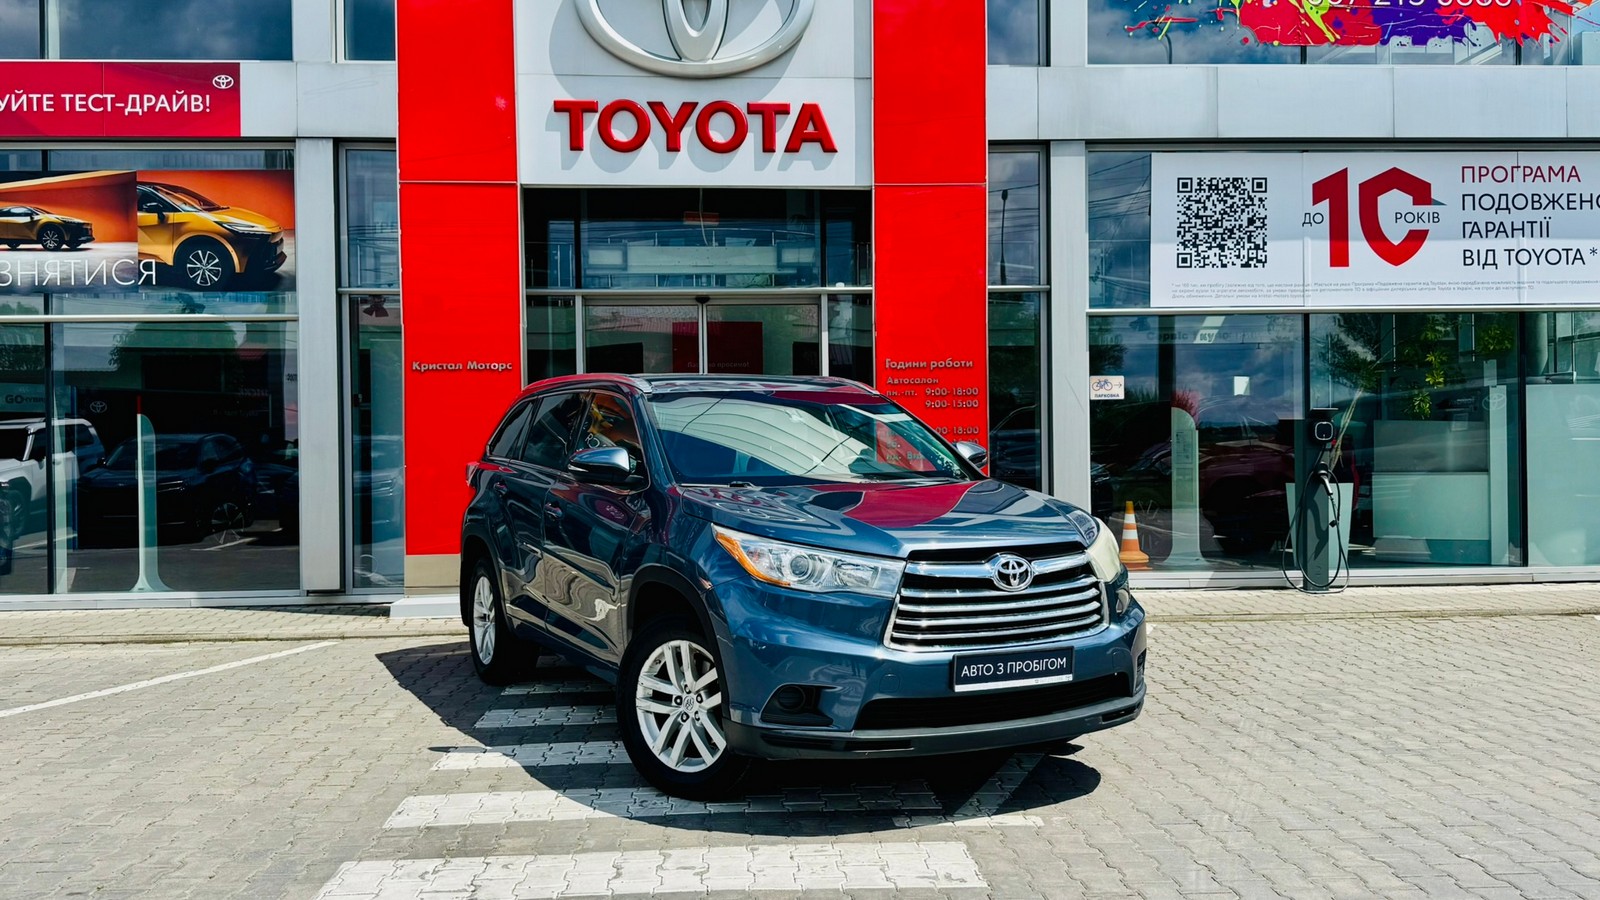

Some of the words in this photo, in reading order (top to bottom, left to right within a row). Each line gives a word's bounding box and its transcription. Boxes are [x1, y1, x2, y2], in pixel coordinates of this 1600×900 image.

[61, 90, 210, 115] ТЕСТ-ДРАЙВ!
[554, 99, 838, 154] TOYOTA
[1461, 165, 1581, 183] ПРОГРАМА
[1302, 212, 1324, 227] ДО
[1395, 211, 1441, 224] РОКІВ
[1462, 216, 1552, 239] ГАРАНТІЇ
[1462, 248, 1498, 270] ВІД
[1504, 248, 1586, 266] TOYOTA
[412, 361, 462, 372] Кристал
[467, 361, 513, 372] Моторс
[885, 358, 927, 370] Години
[930, 358, 973, 370] роботи
[925, 387, 979, 396] 9:00-18:00
[925, 399, 979, 408] 9:00-15:00
[936, 426, 979, 435] 00-18:00
[961, 663, 994, 677] АВТО
[996, 662, 1004, 675] З
[1007, 657, 1067, 674] ПРОБІГОМ
